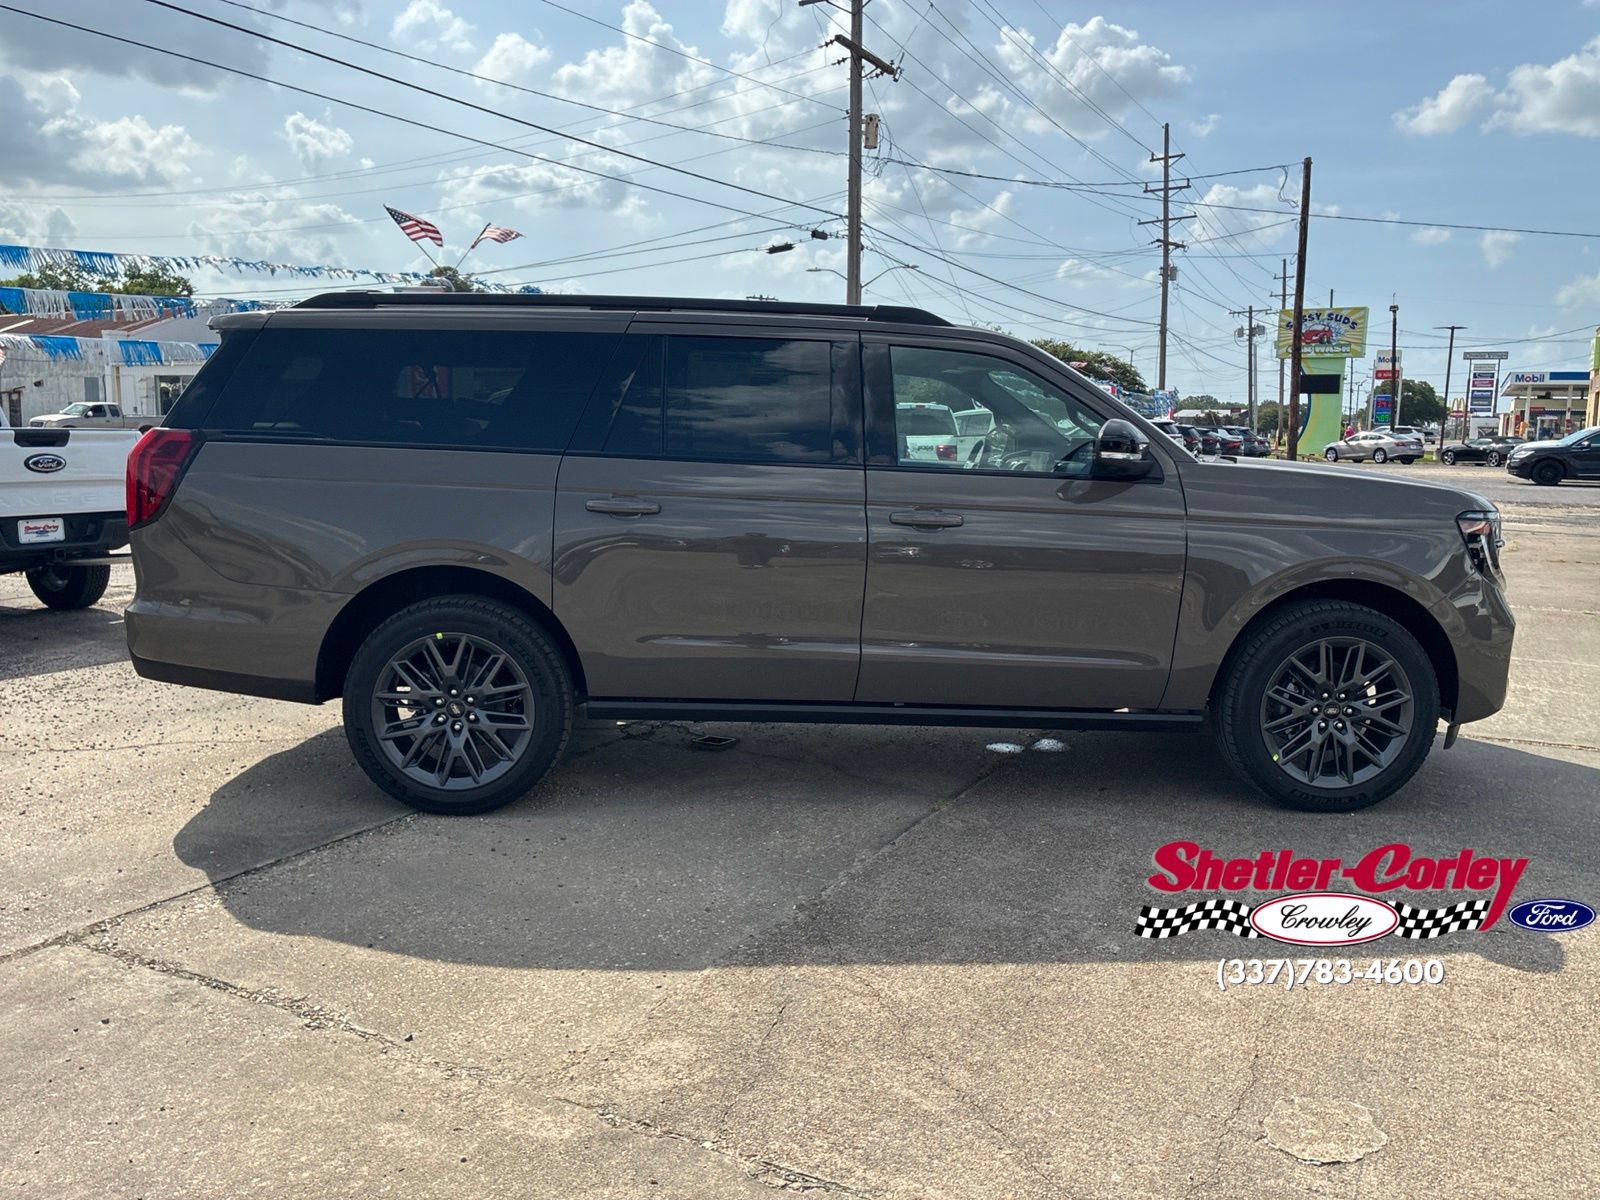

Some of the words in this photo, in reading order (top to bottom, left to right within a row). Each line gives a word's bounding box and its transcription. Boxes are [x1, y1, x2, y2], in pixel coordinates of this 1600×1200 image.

[1286, 312, 1321, 330] SSSY
[1327, 312, 1358, 330] SUDS
[1314, 344, 1350, 354] WASH
[1514, 374, 1545, 383] Mobil
